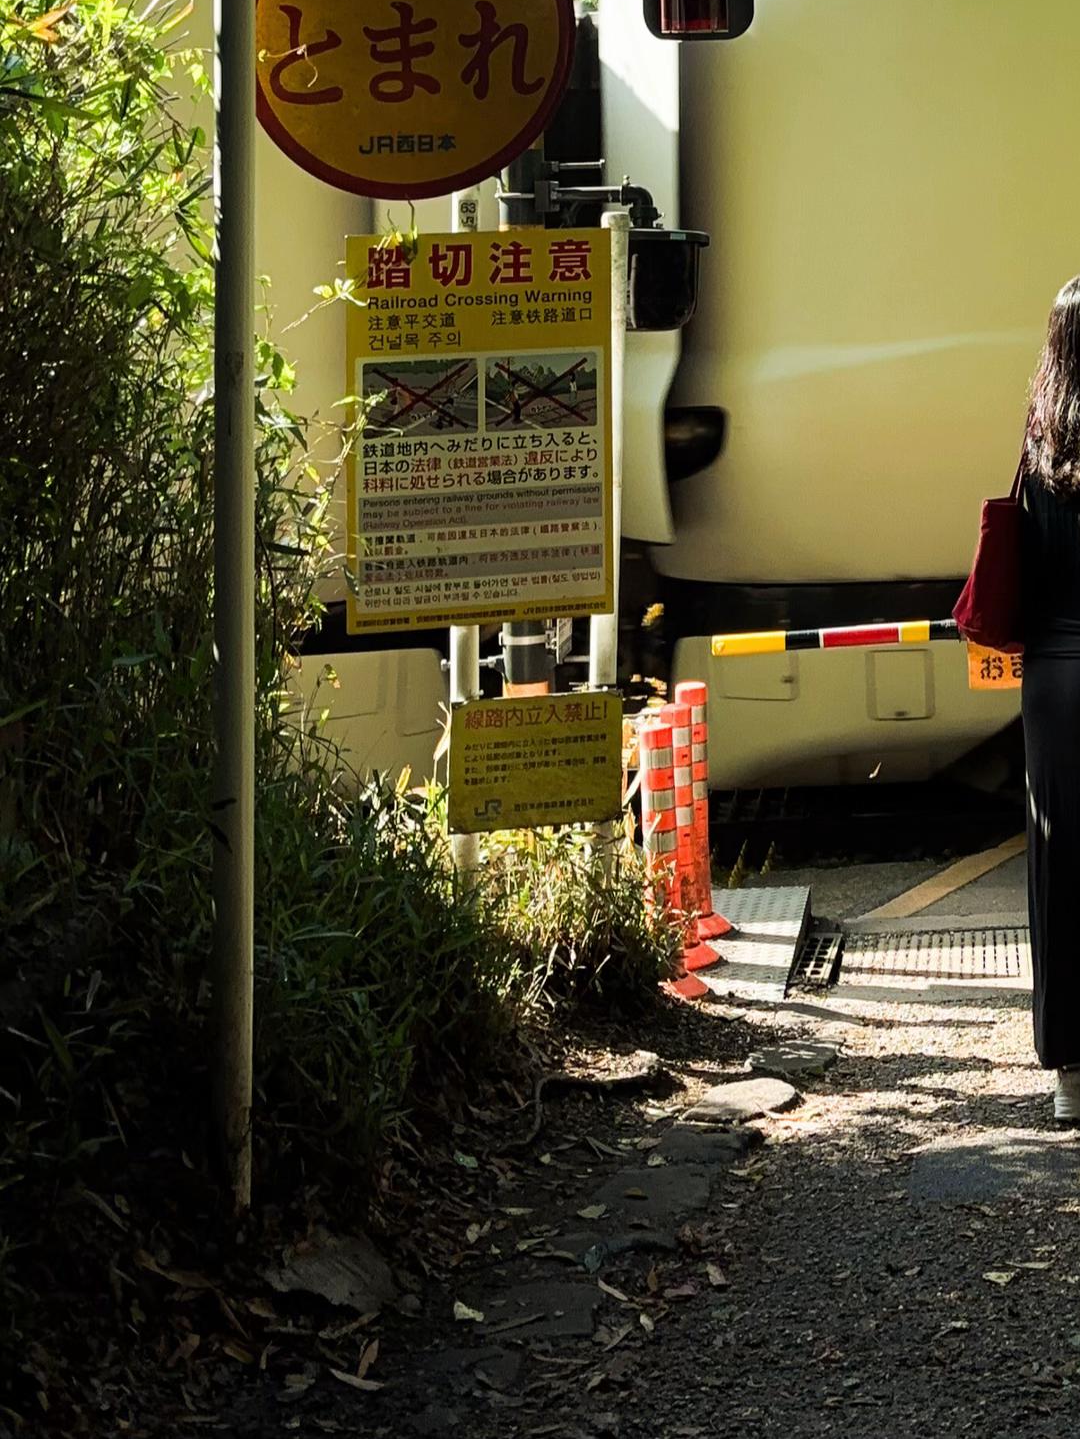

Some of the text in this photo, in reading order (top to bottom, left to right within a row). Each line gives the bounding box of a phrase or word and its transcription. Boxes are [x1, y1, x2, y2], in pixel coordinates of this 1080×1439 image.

[270, 1, 545, 105] とまれ
[359, 134, 456, 155] JR西日本
[367, 239, 592, 289] 踏切注意
[368, 289, 592, 310] Railroad Crossing Warning
[368, 307, 592, 331] 注意平交道 注意铁路道口
[368, 331, 461, 350] 건널목 주의
[363, 485, 600, 508] Persons entering railway grounds without permission
[464, 700, 607, 731] 線路内立入禁止!
